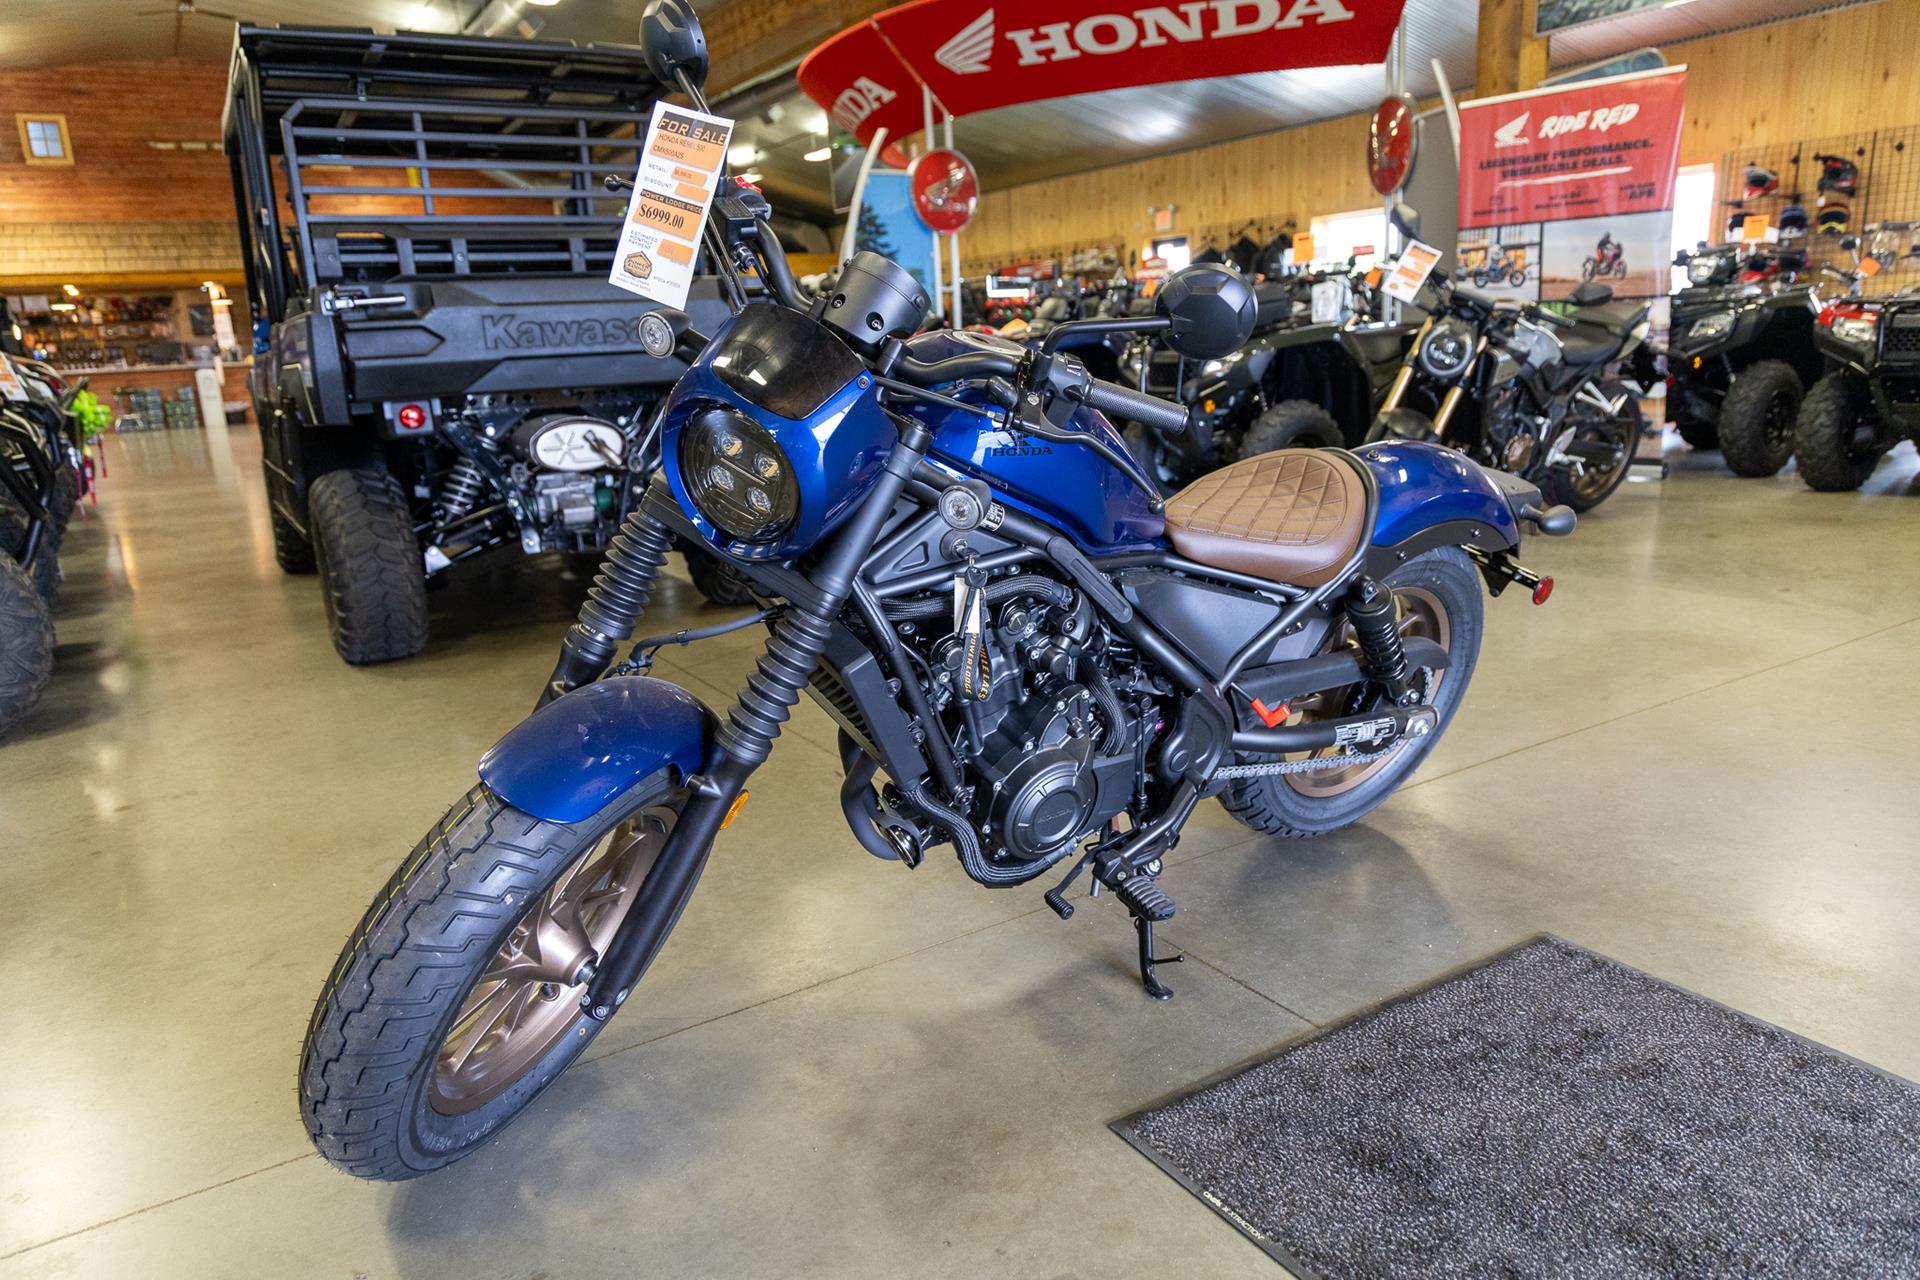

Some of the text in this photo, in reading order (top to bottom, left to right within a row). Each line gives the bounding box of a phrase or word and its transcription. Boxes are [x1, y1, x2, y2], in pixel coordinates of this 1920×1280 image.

[1005, 0, 1355, 66] HONDA
[657, 118, 728, 145] FOR SALE
[1538, 103, 1640, 140] RIDE RED
[659, 133, 680, 146] HONDA
[1480, 150, 1549, 170] LEGENDARY
[1502, 160, 1579, 178] UNBEATABLE
[641, 190, 704, 215] POWER LODGE PRICE
[639, 203, 685, 230] $6999.00
[992, 445, 1054, 457] HONDA
